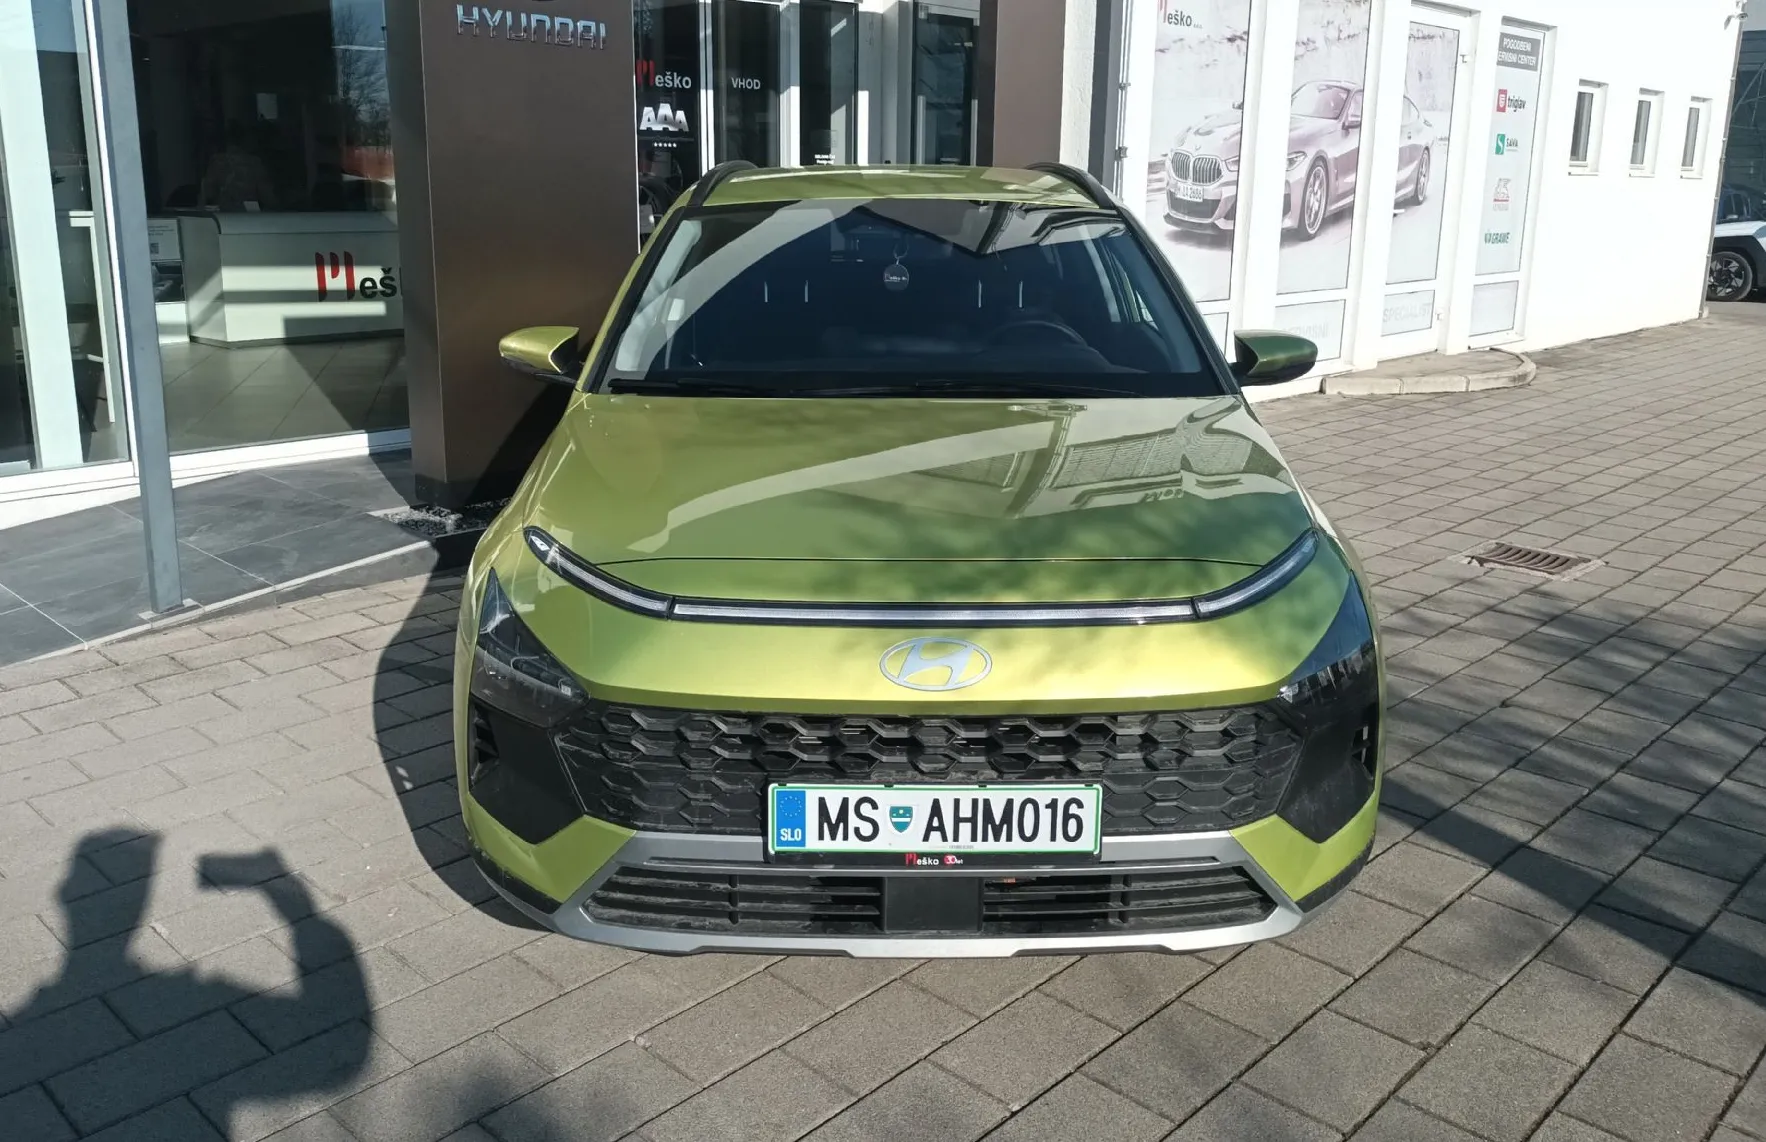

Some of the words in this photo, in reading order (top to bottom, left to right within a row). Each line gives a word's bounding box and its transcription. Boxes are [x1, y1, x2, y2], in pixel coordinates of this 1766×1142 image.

[456, 4, 606, 50] HYUNDAI
[731, 77, 761, 90] VHOD
[1507, 95, 1527, 113] triglav
[639, 103, 690, 132] AAA
[315, 250, 401, 302] Meš
[817, 796, 880, 842] MS
[922, 797, 1085, 843] AHM016
[780, 828, 802, 841] SLO
[904, 852, 940, 866] Meško
